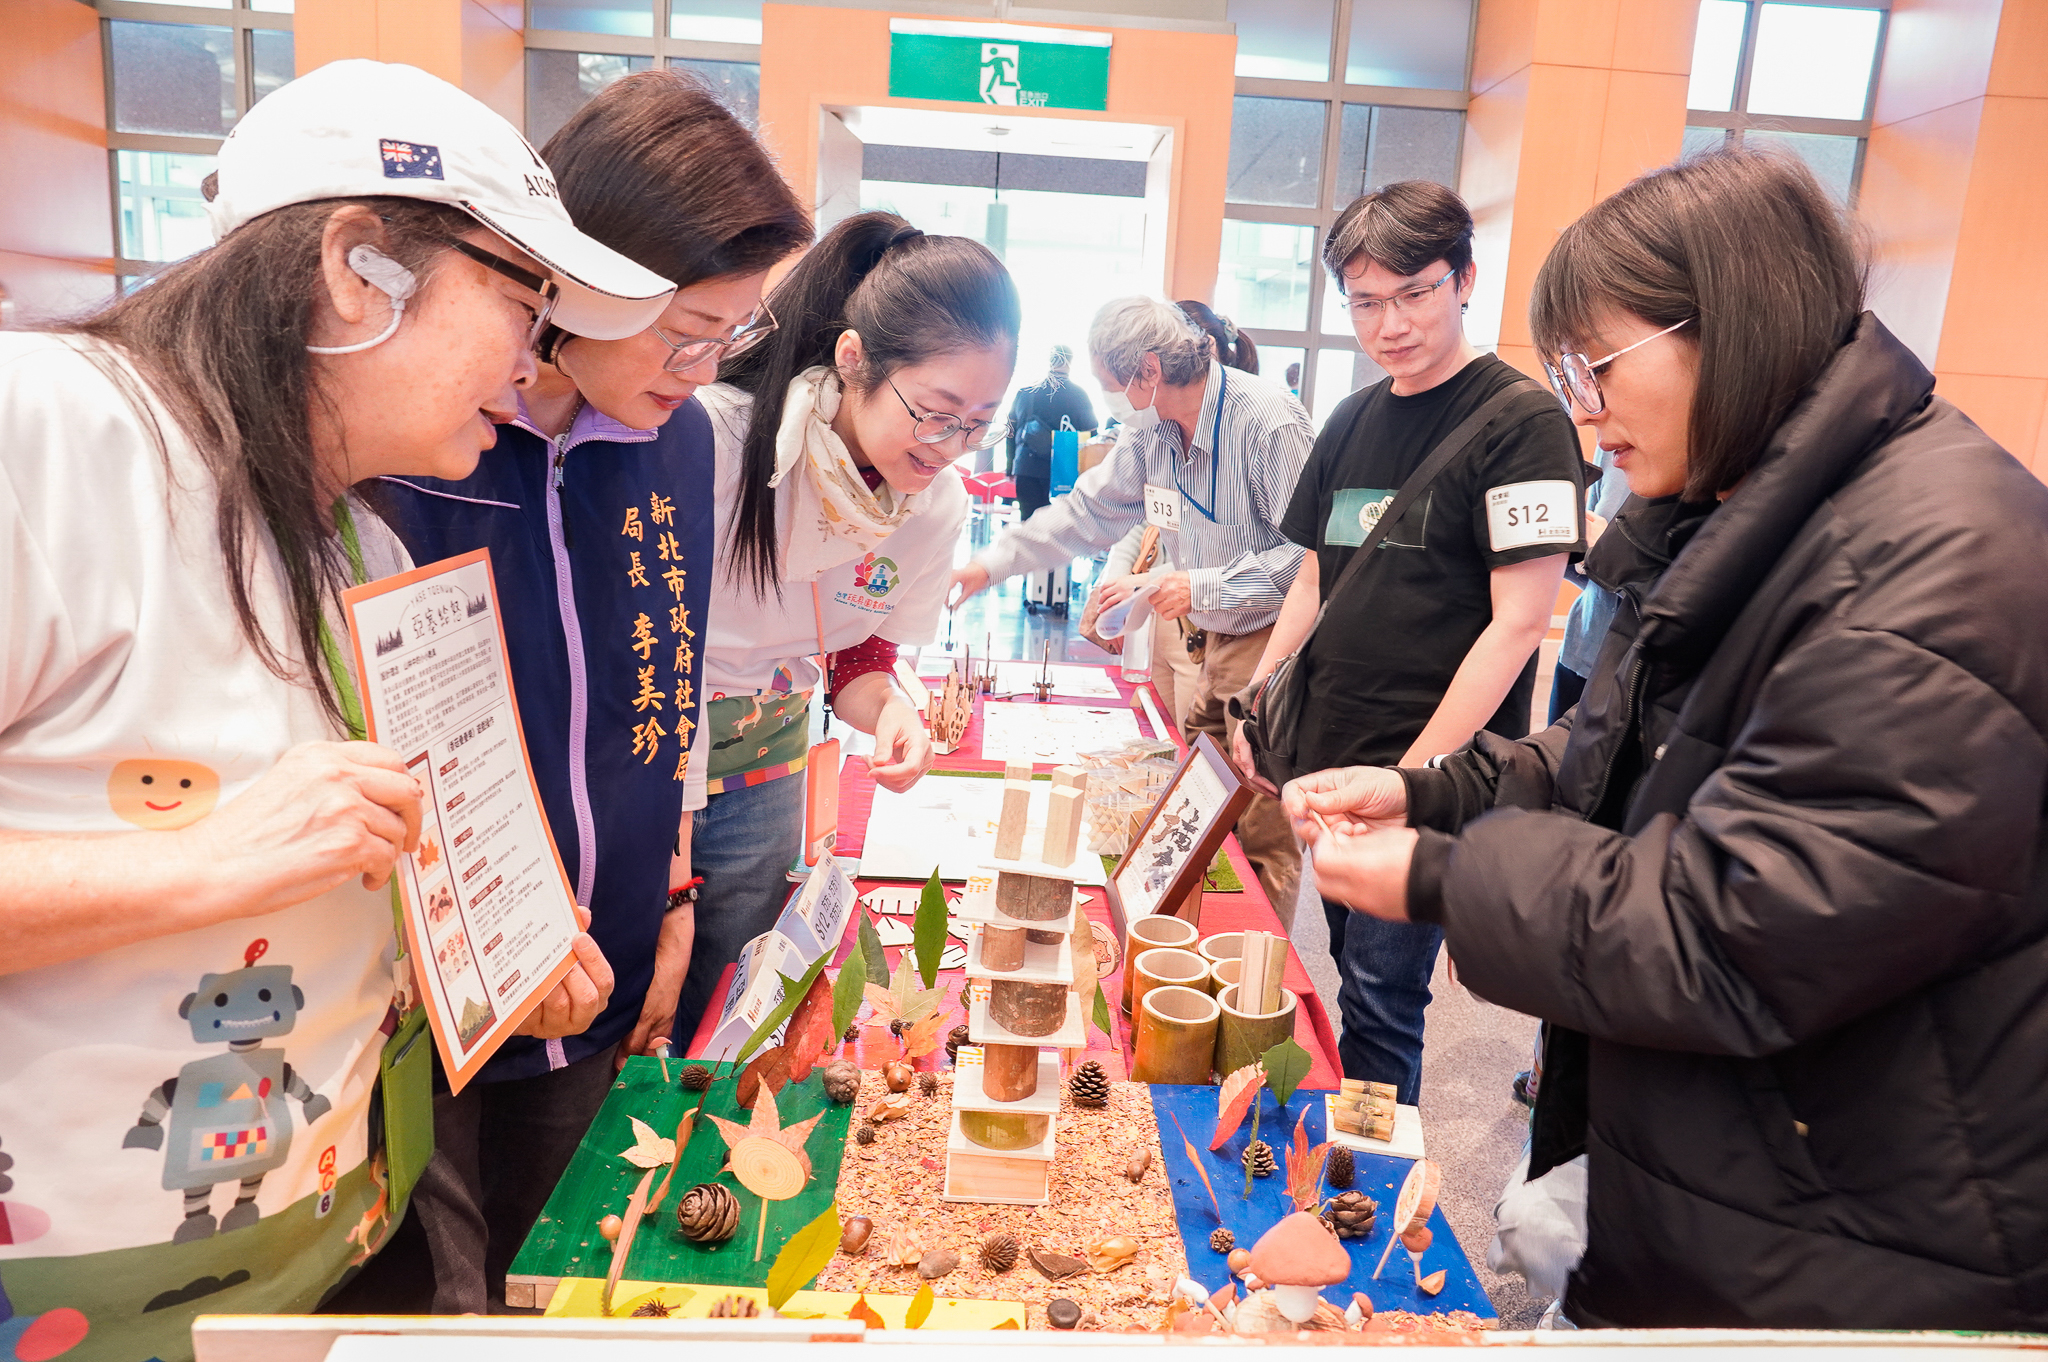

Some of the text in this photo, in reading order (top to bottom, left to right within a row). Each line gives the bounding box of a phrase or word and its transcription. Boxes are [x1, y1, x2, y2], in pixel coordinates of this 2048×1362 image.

[1019, 98, 1047, 107] EXIT
[473, 208, 510, 235] AUSTRALIA
[532, 250, 568, 276] AUSTRALIA
[1153, 500, 1173, 517] S13
[1507, 503, 1549, 527] S12
[620, 506, 667, 765] 局長 李美珍
[648, 491, 697, 782] 新北市政府社會局
[814, 911, 831, 941] S12
